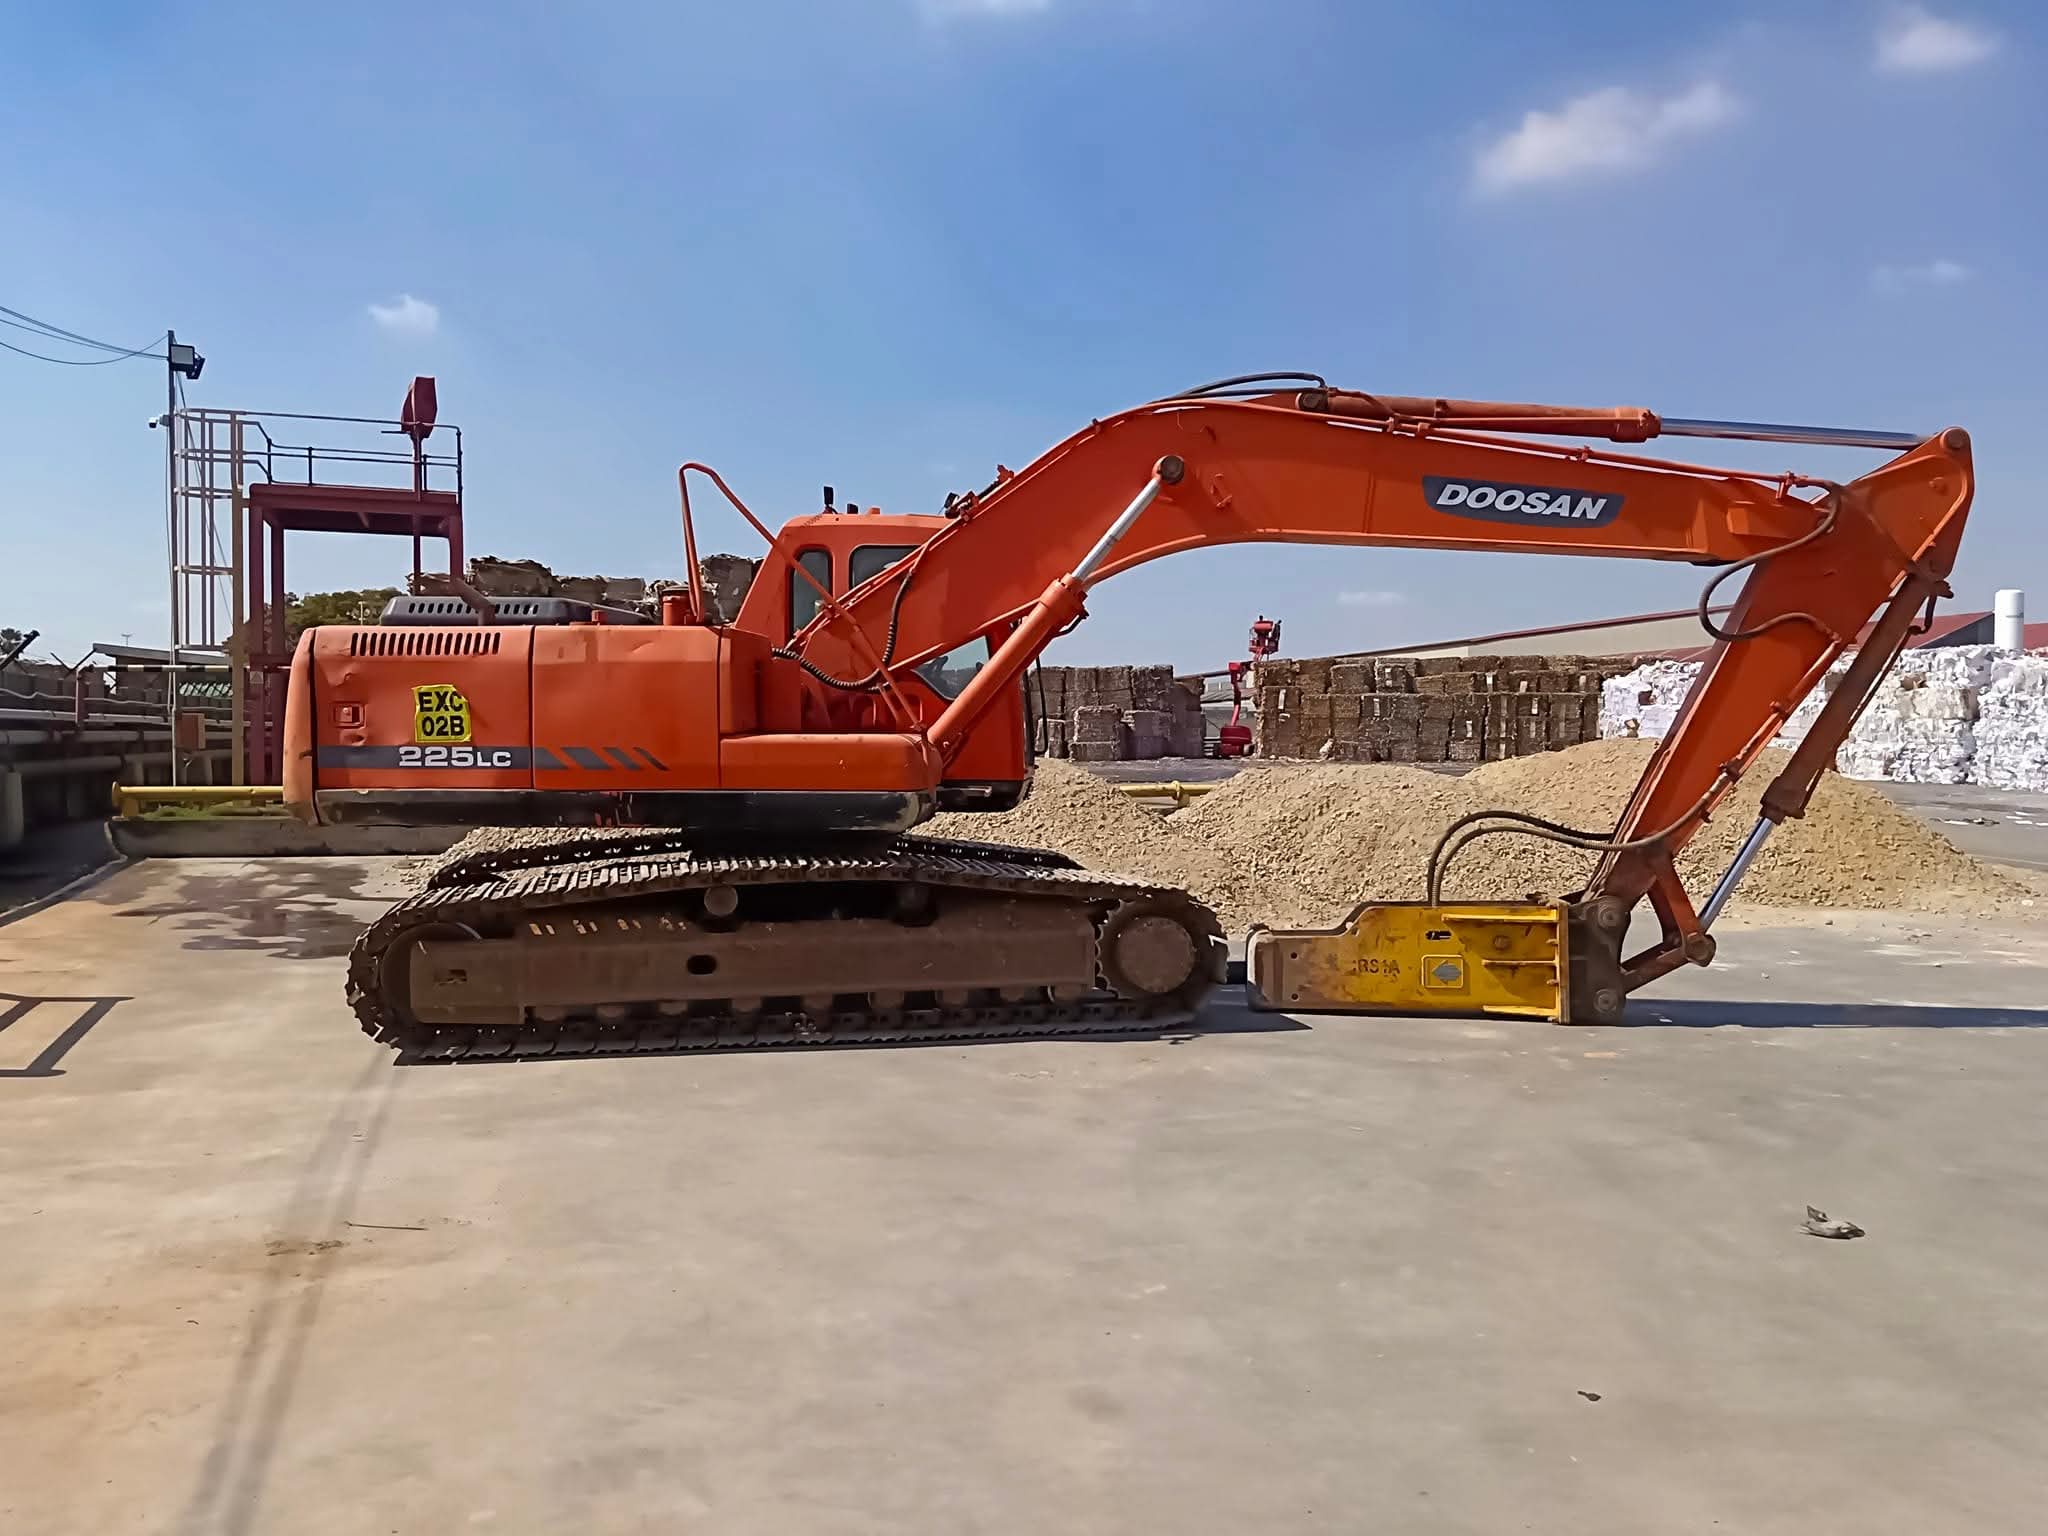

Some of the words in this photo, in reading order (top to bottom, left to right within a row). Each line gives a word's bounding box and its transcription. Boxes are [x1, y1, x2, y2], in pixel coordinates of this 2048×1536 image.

[1437, 484, 1607, 519] DOOSAN
[418, 691, 463, 712] EXC
[422, 715, 465, 736] 02B
[399, 746, 512, 767] 225LC
